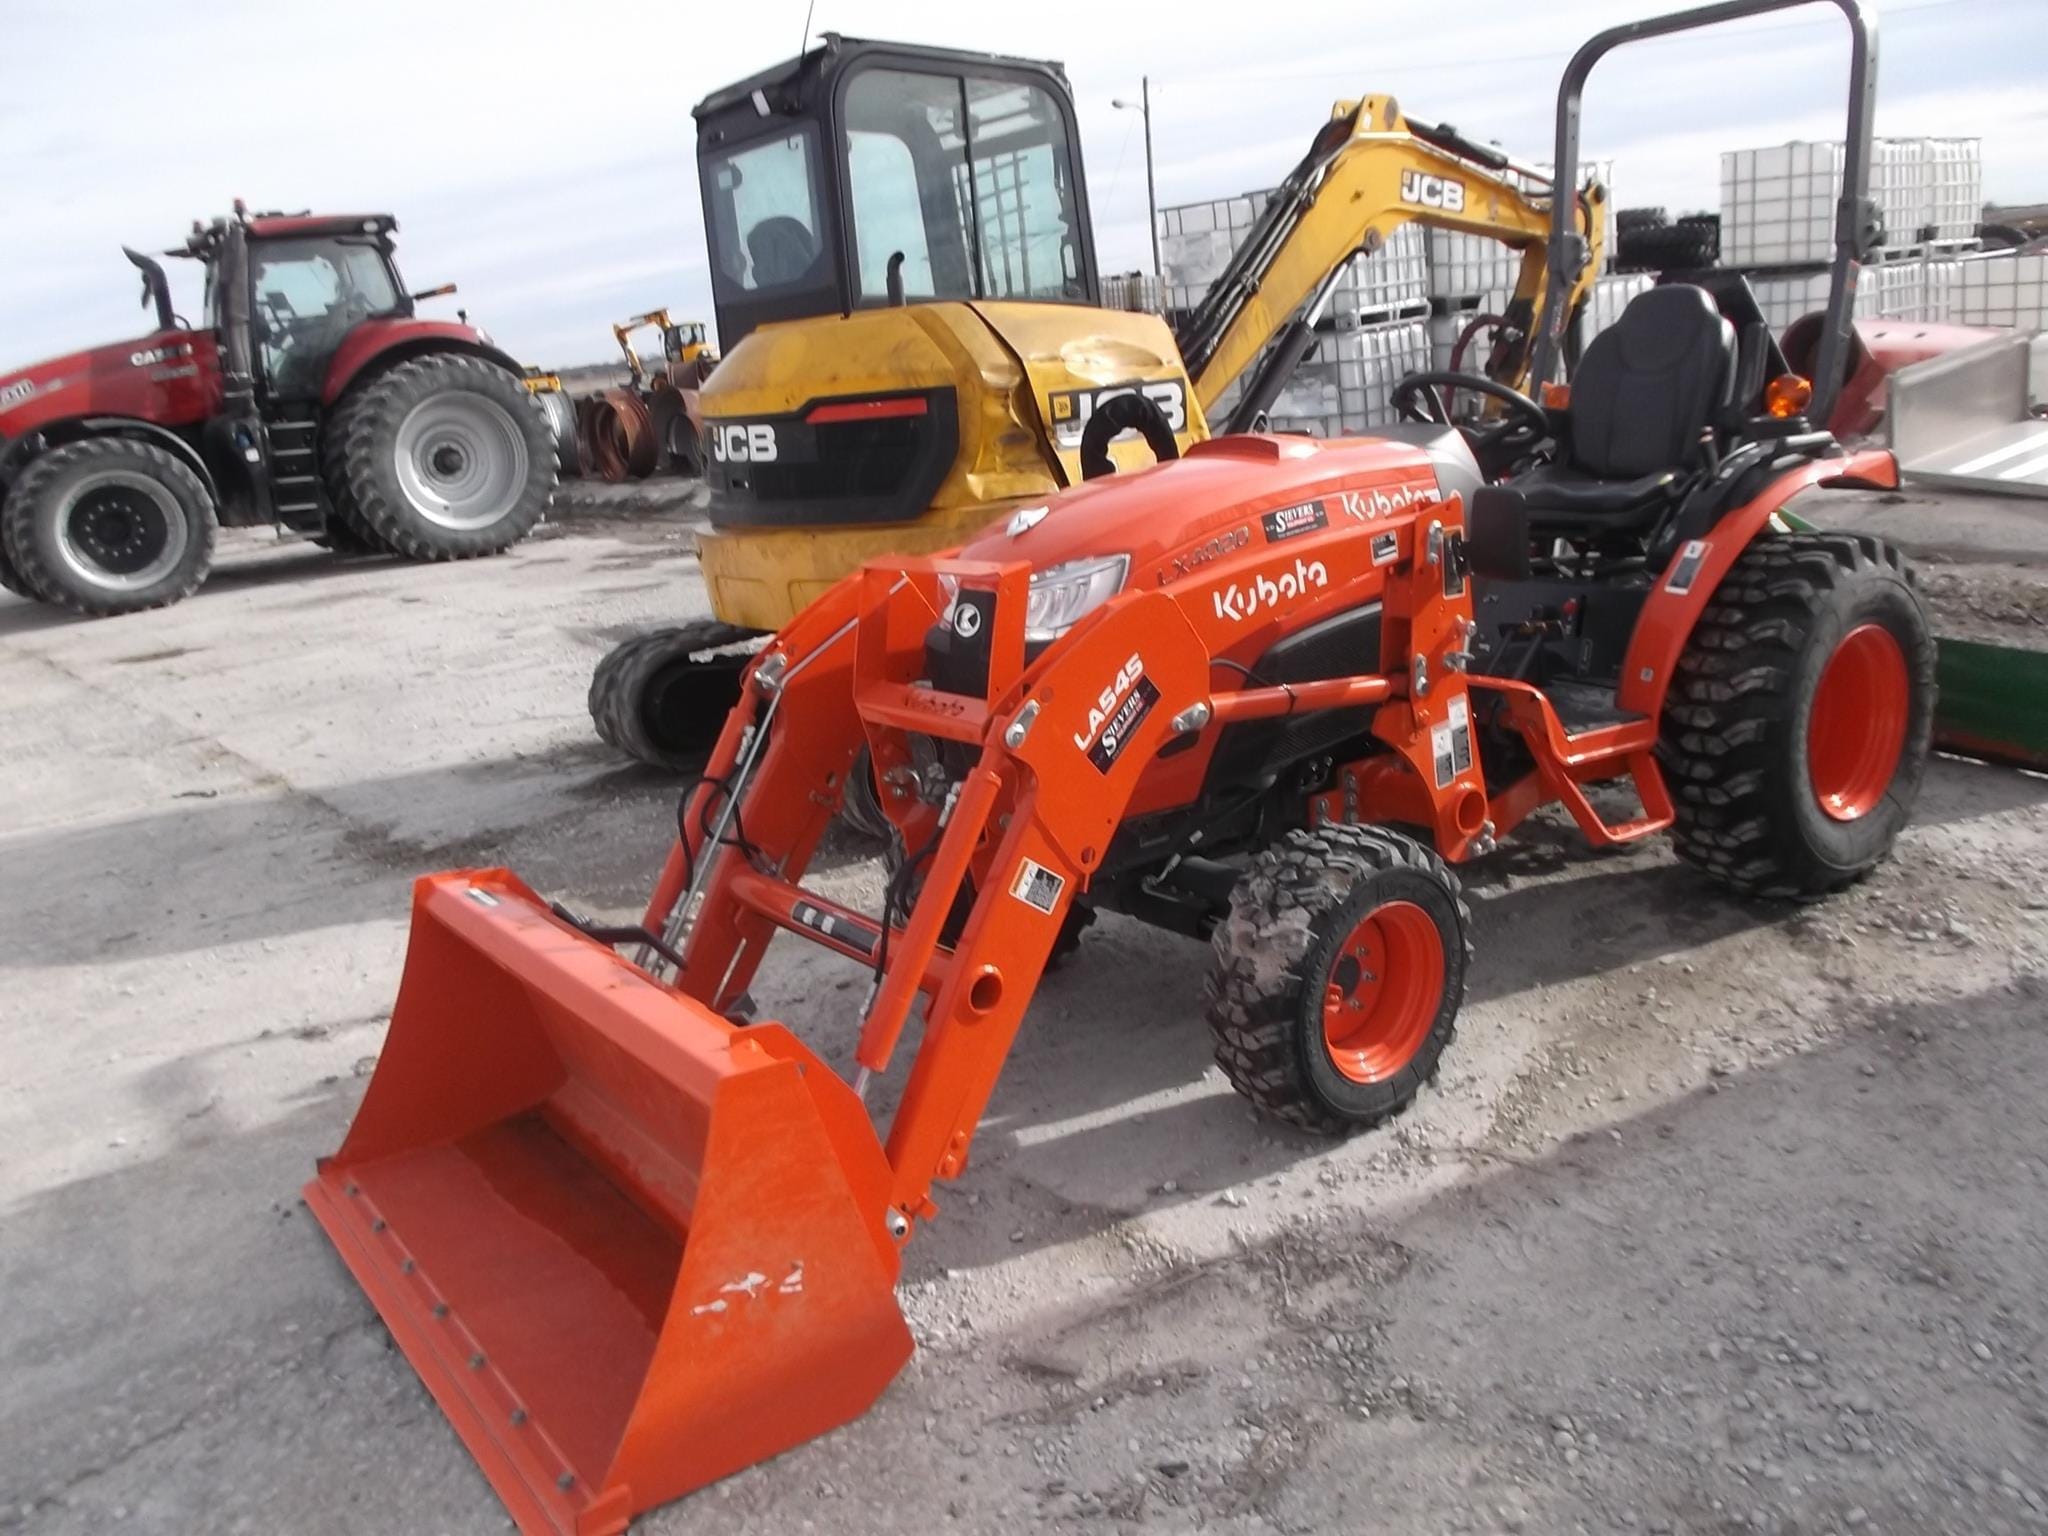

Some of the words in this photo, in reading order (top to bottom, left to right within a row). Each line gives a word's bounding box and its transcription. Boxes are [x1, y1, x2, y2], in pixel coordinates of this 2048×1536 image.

[1402, 171, 1464, 211] JCB
[1056, 382, 1185, 447] JB
[713, 424, 778, 462] JCB
[1275, 503, 1314, 533] SIEVERS
[1340, 485, 1426, 521] Kubota
[1213, 558, 1328, 622] Kubota
[1073, 652, 1144, 751] LA545
